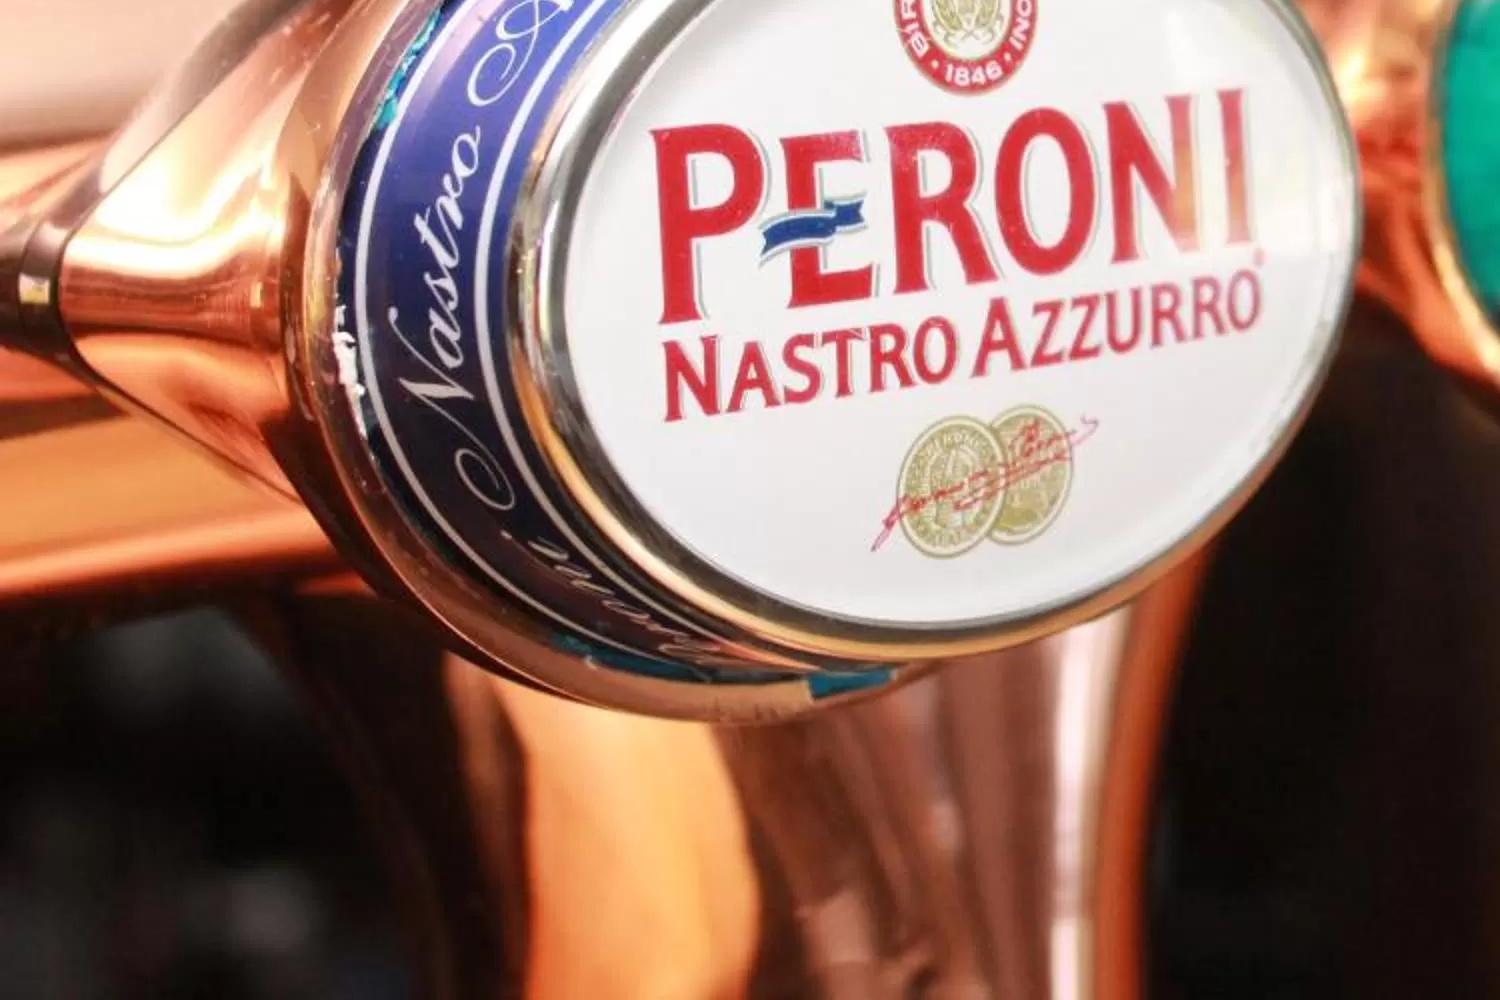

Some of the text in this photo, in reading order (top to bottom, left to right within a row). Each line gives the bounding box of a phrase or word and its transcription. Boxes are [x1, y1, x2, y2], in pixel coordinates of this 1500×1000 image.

[944, 60, 1003, 86] 1846
[650, 87, 1255, 325] PERONI
[388, 124, 515, 511] Nastro
[661, 269, 1262, 423] NASTRO AZZURRO
